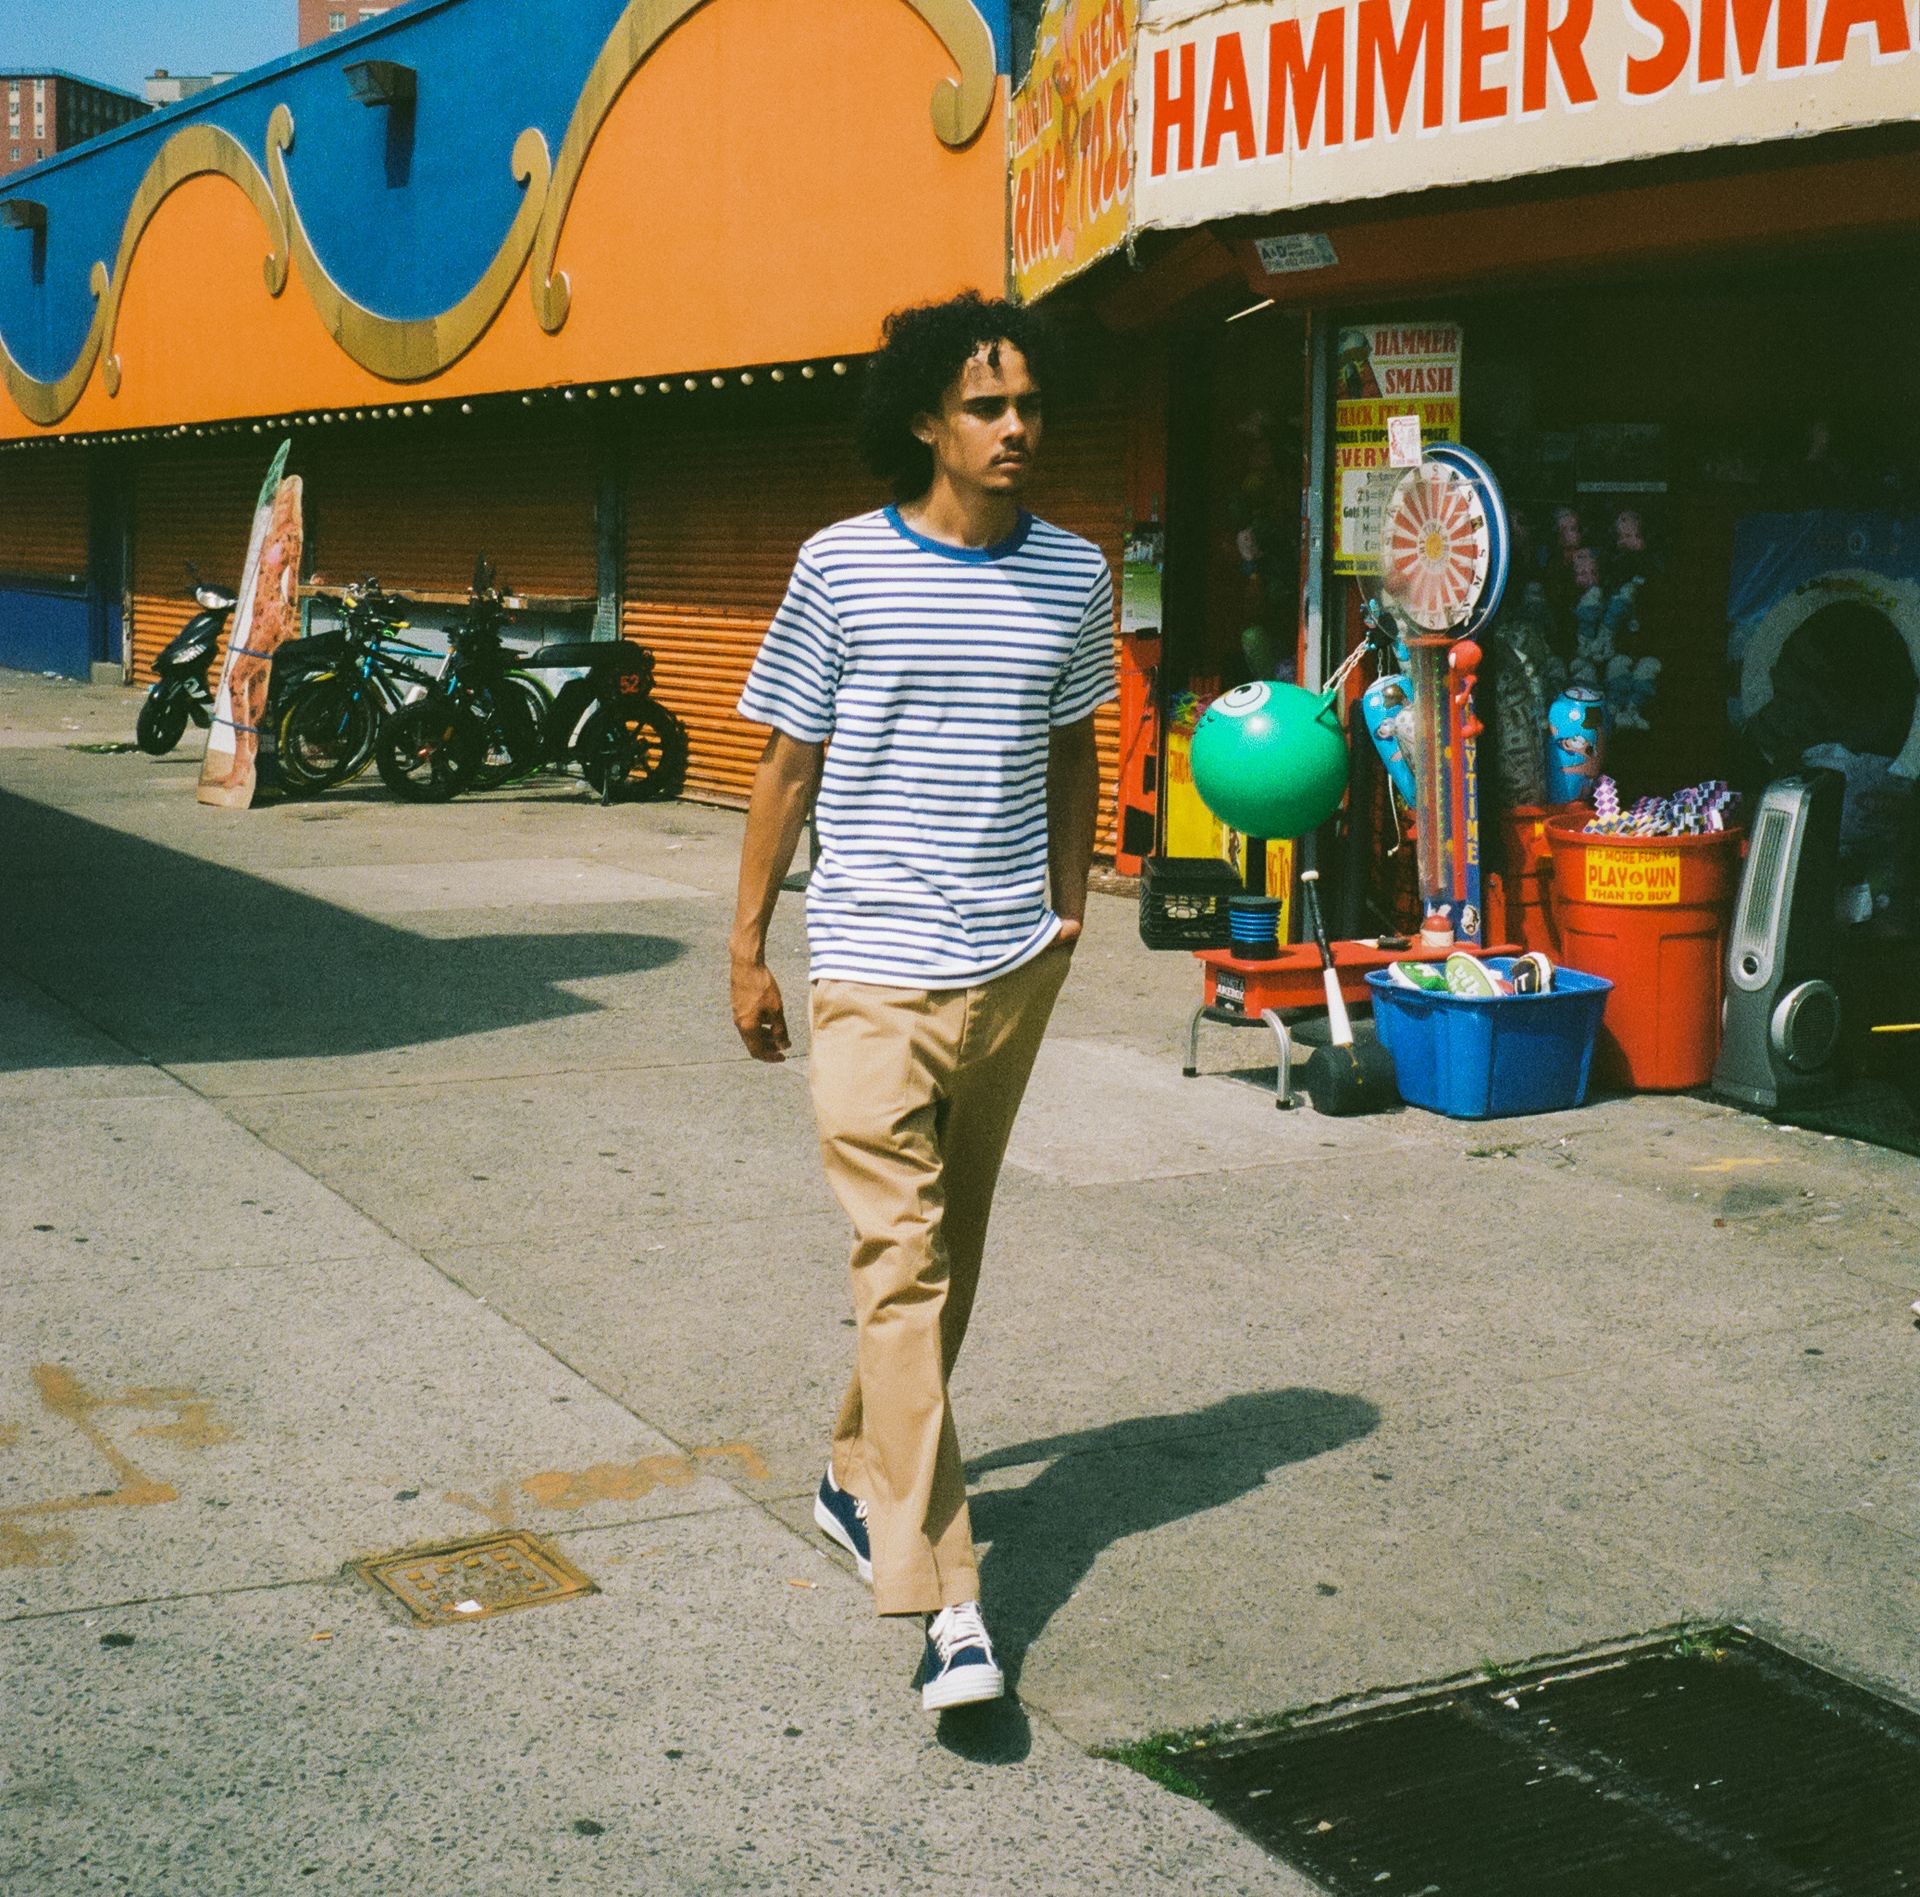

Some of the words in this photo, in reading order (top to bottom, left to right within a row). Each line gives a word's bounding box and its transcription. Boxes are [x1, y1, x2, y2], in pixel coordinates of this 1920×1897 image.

[1151, 0, 1598, 177] HAMMER
[1014, 136, 1065, 273] RING
[1375, 330, 1456, 356] HAMMER
[1385, 366, 1453, 394] SMASH
[1604, 849, 1635, 864] MORE
[1588, 865, 1628, 888] PLAY
[1645, 866, 1676, 888] WIN
[1592, 888, 1623, 901] THAN
[1628, 890, 1644, 901] TO
[1647, 889, 1671, 901] BUY
